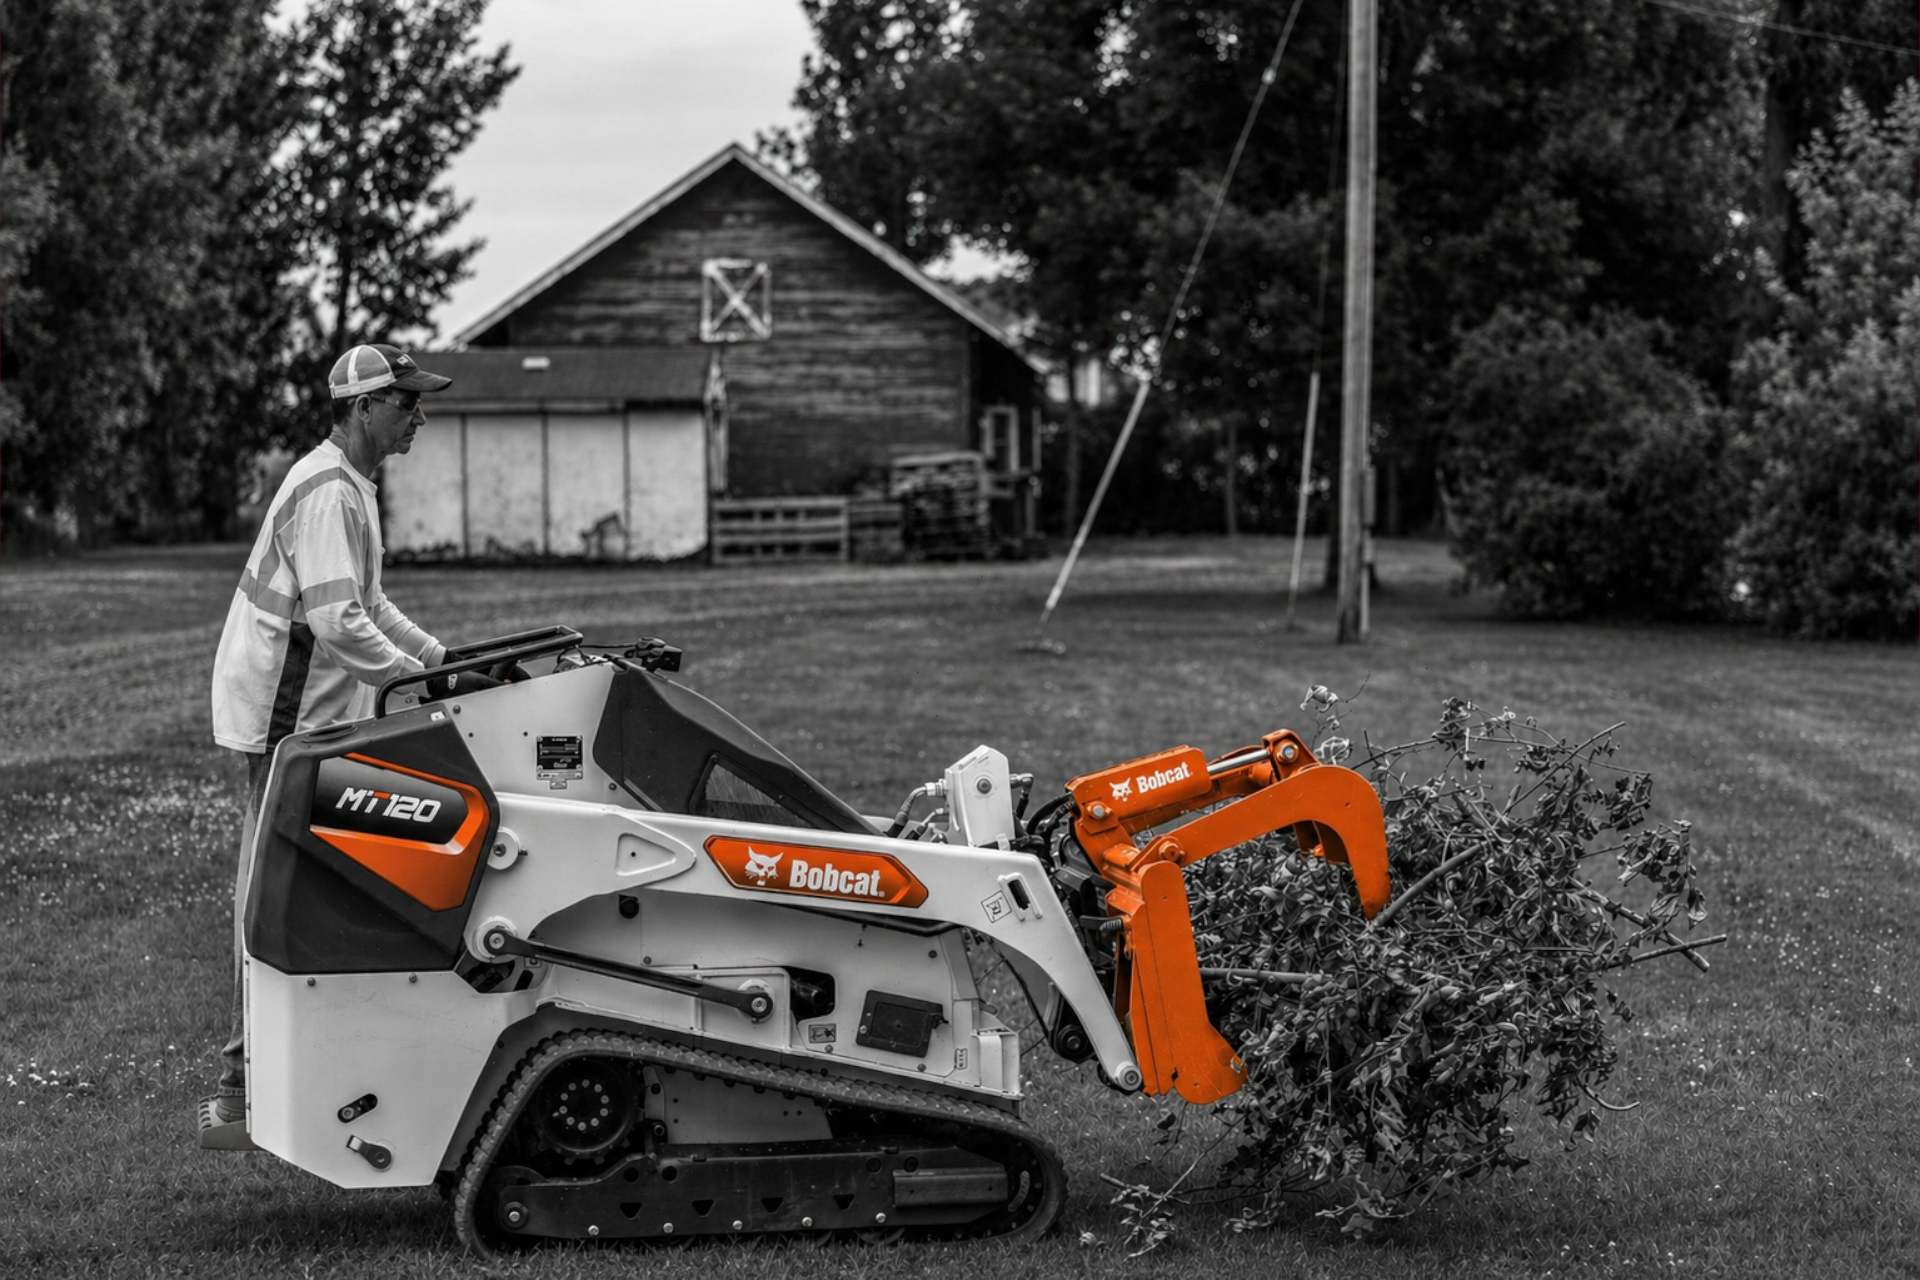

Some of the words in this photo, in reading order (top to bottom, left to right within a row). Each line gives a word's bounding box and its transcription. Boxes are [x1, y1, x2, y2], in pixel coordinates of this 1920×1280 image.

[1136, 761, 1191, 794] Bobcat
[335, 787, 441, 823] MT120
[789, 859, 880, 897] Bobcat
